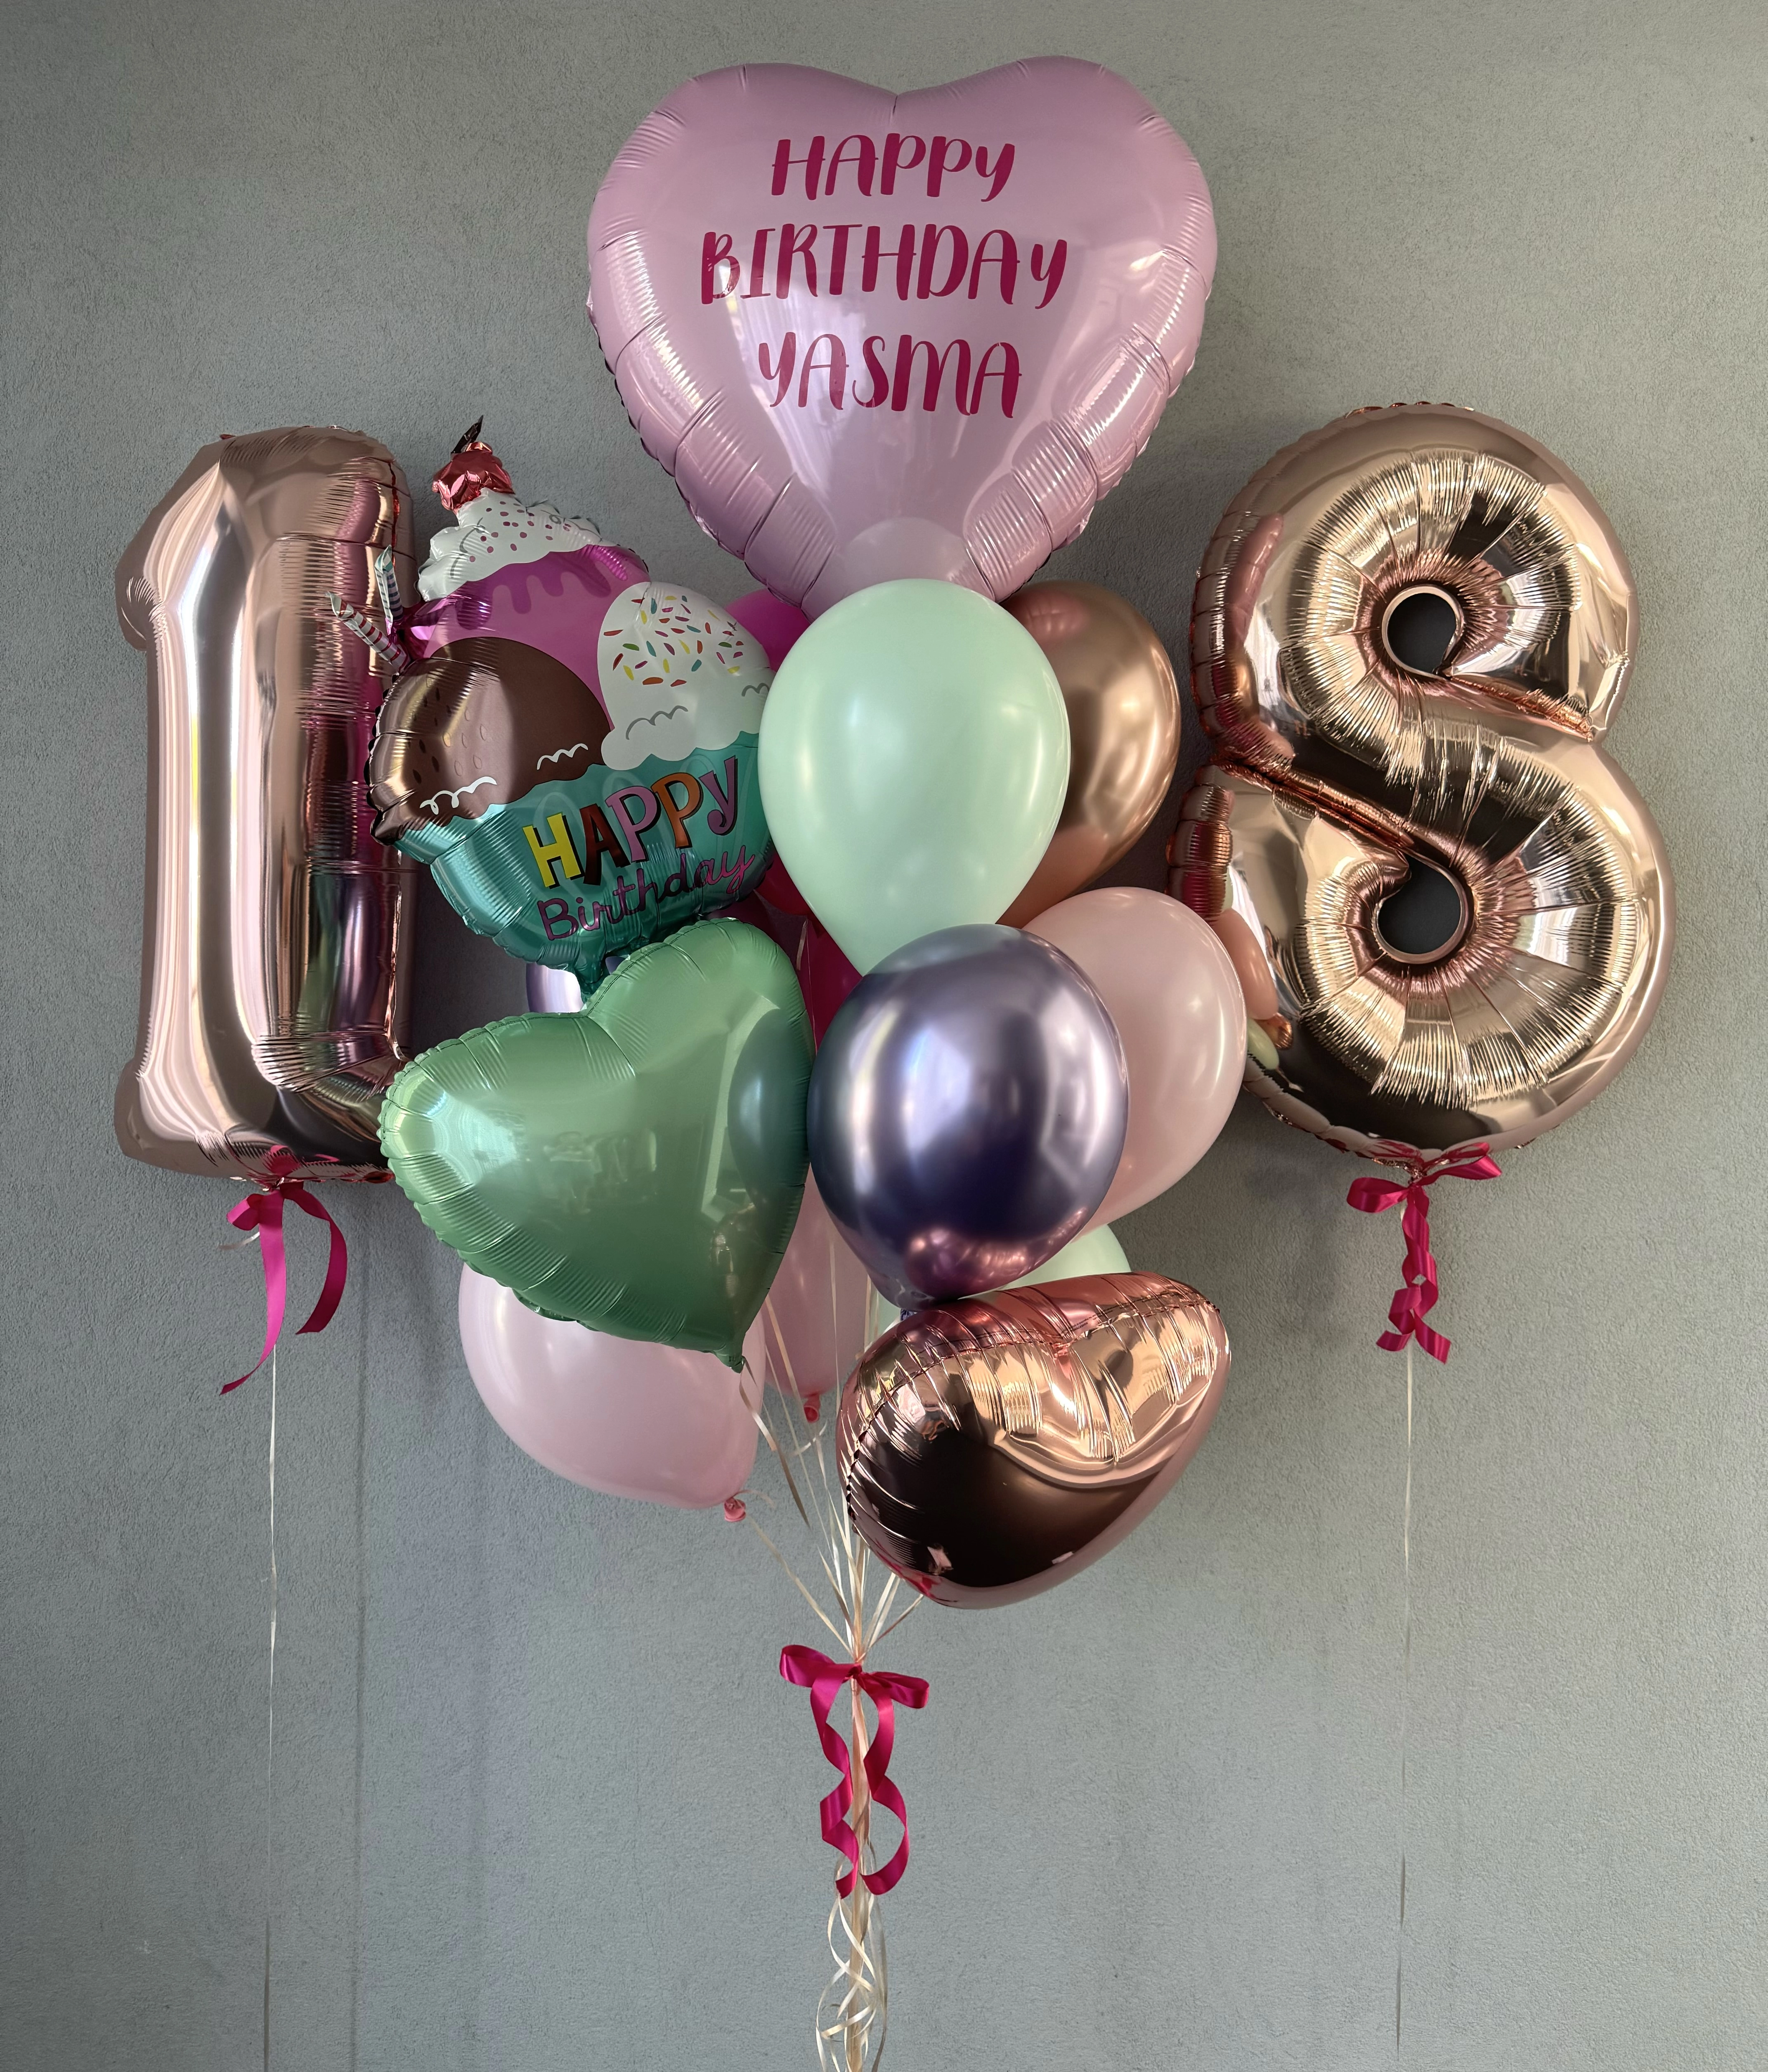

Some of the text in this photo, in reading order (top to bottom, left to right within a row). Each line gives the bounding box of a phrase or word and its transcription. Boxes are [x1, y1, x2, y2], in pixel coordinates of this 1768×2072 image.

[771, 133, 1015, 202] HAPPY
[701, 224, 1067, 309] BIRTHDAY
[759, 332, 1022, 418] YASMA
[522, 755, 737, 889] HAPPY
[537, 845, 755, 941] Birthday
